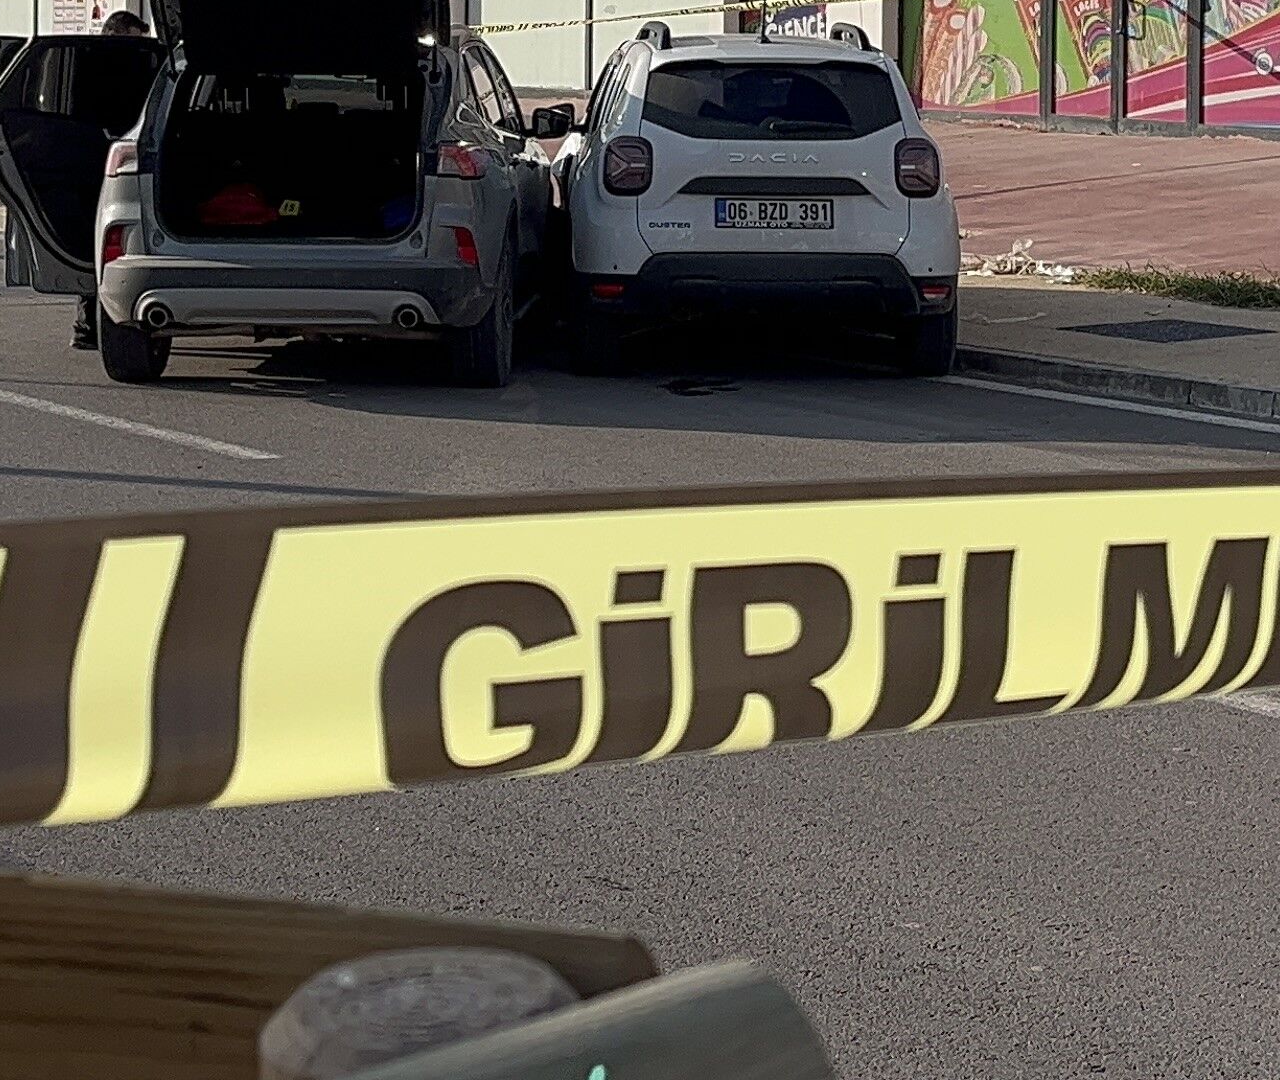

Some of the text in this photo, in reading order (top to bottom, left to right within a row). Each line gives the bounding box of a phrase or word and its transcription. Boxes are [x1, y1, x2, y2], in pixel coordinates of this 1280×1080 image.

[728, 152, 820, 163] DACIA
[727, 202, 828, 222] 06 BZD 391
[648, 221, 691, 229] DUSTER
